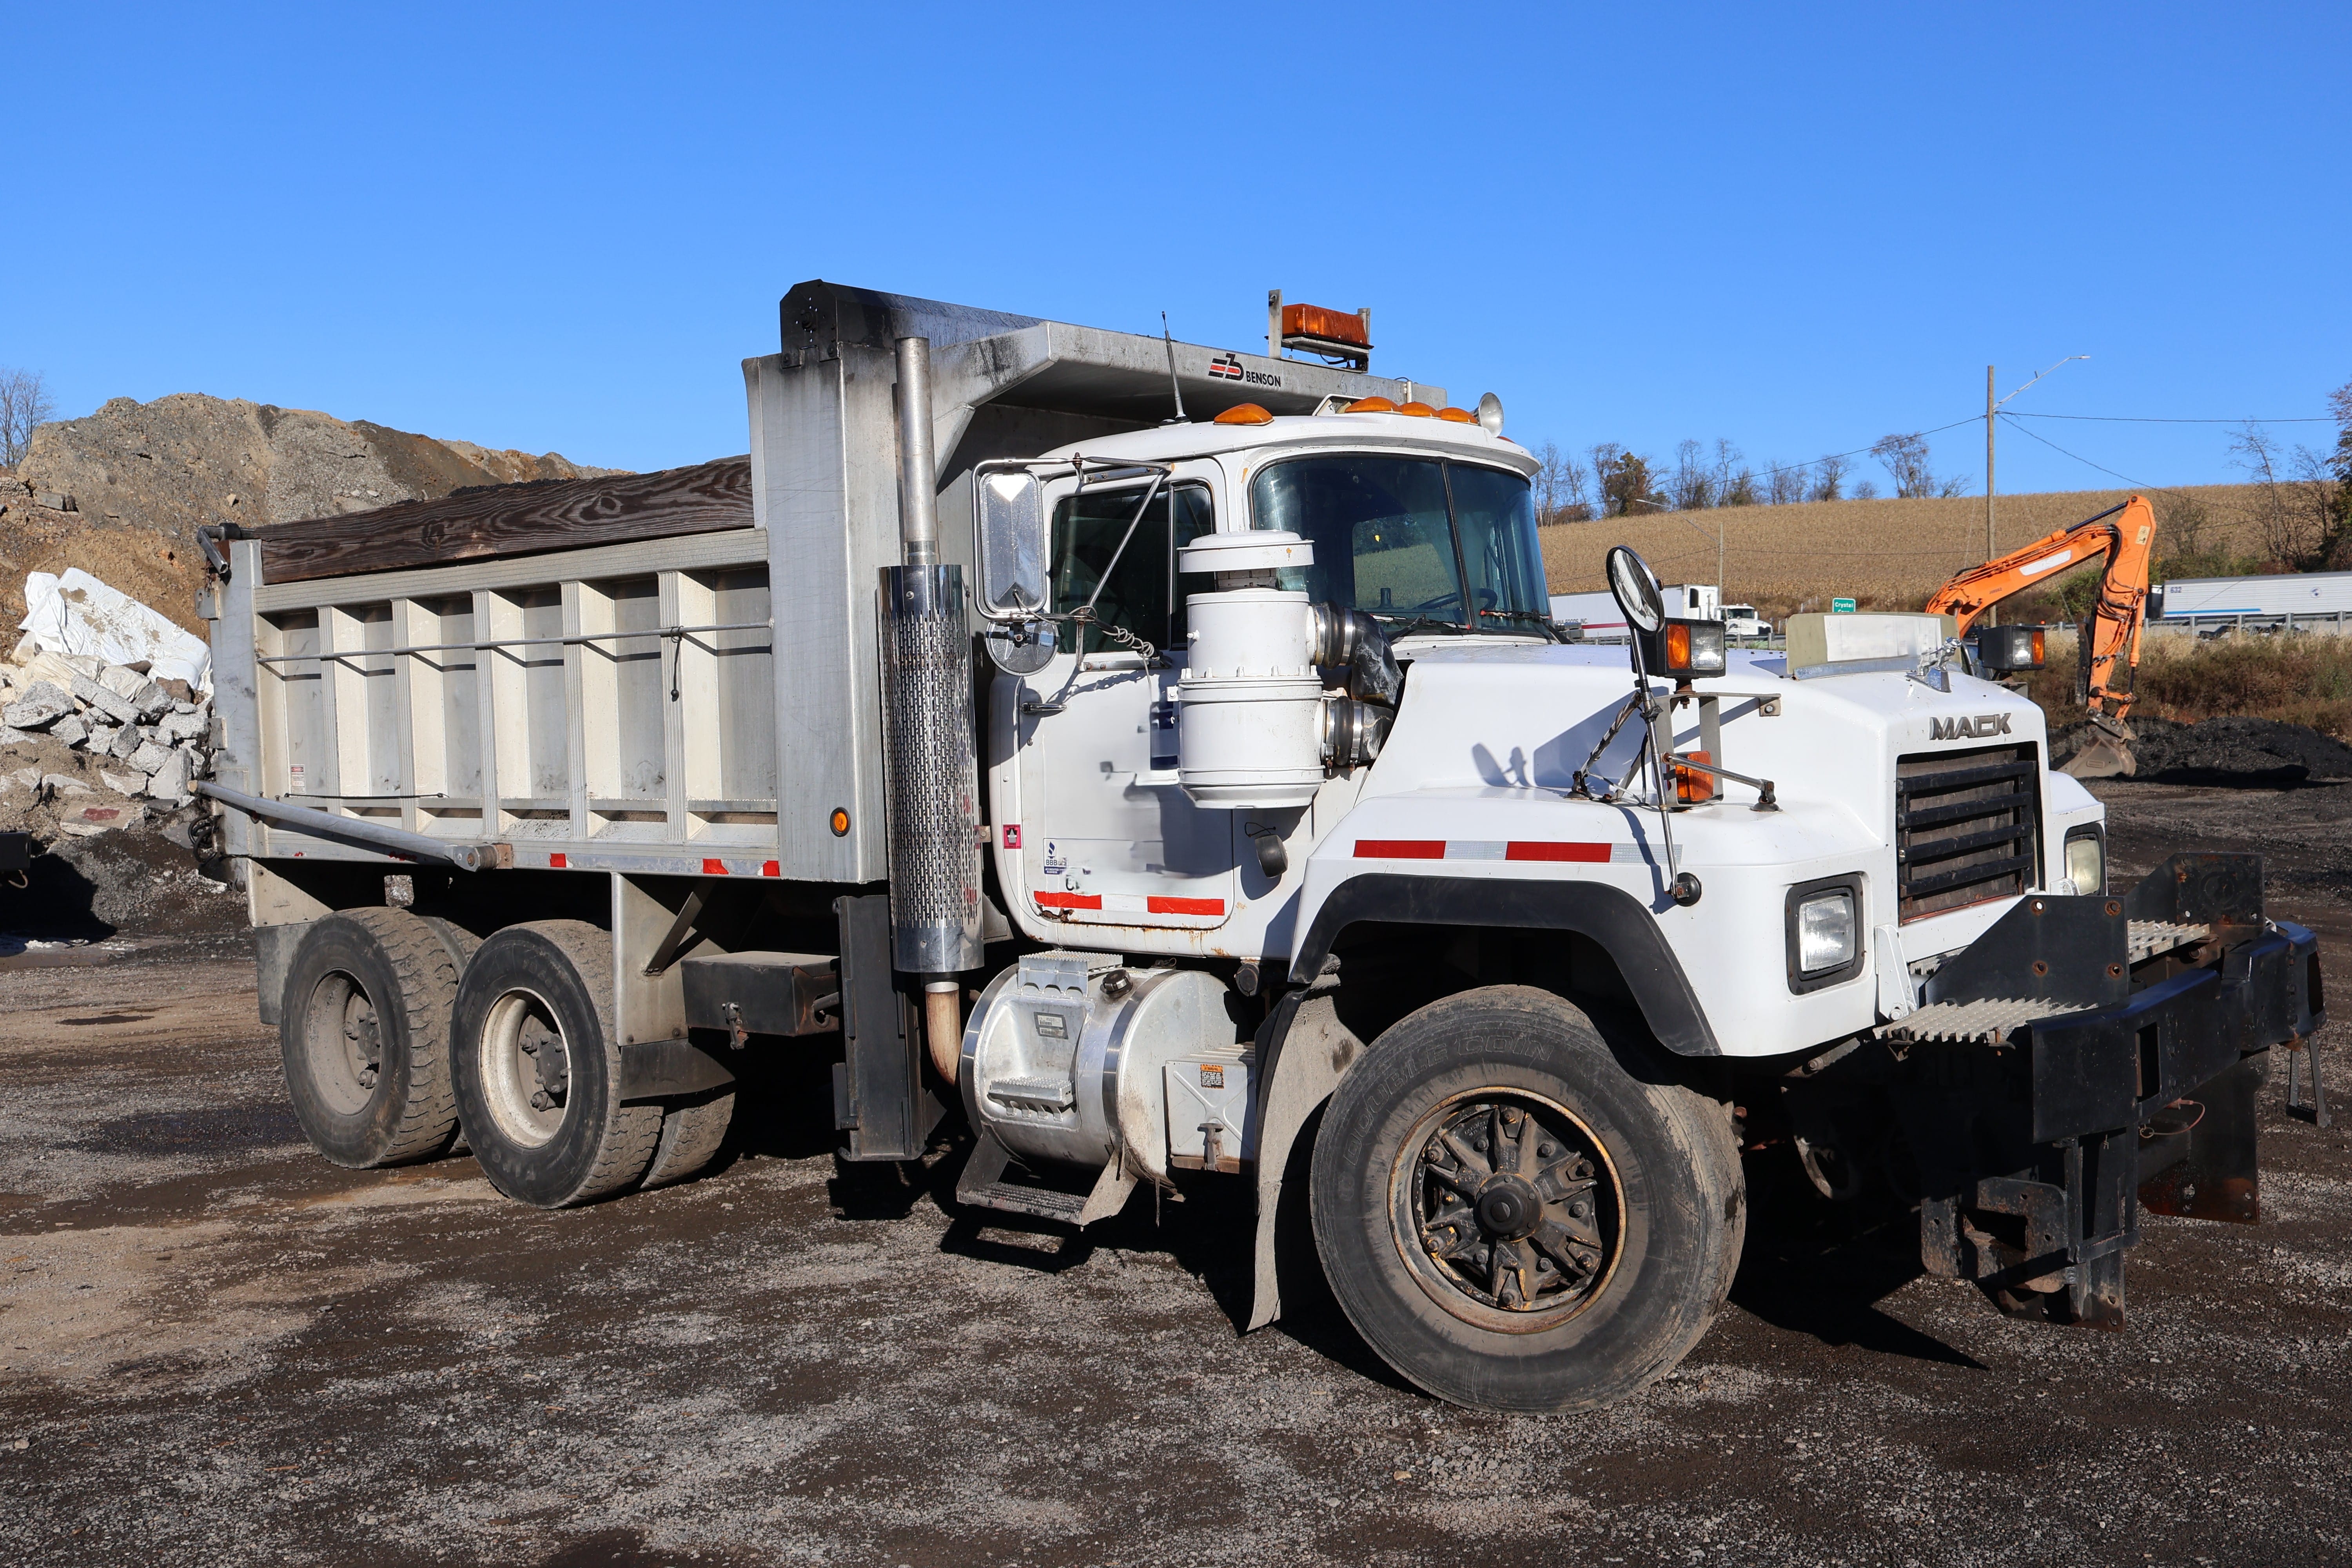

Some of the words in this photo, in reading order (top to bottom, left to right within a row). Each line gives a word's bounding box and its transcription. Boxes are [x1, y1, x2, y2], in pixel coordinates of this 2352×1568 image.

[1246, 370, 1281, 387] BENSON
[1929, 712, 2012, 740] MACK
[1343, 1042, 1449, 1166] DOUBLE
[1454, 1035, 1554, 1061] COIN
